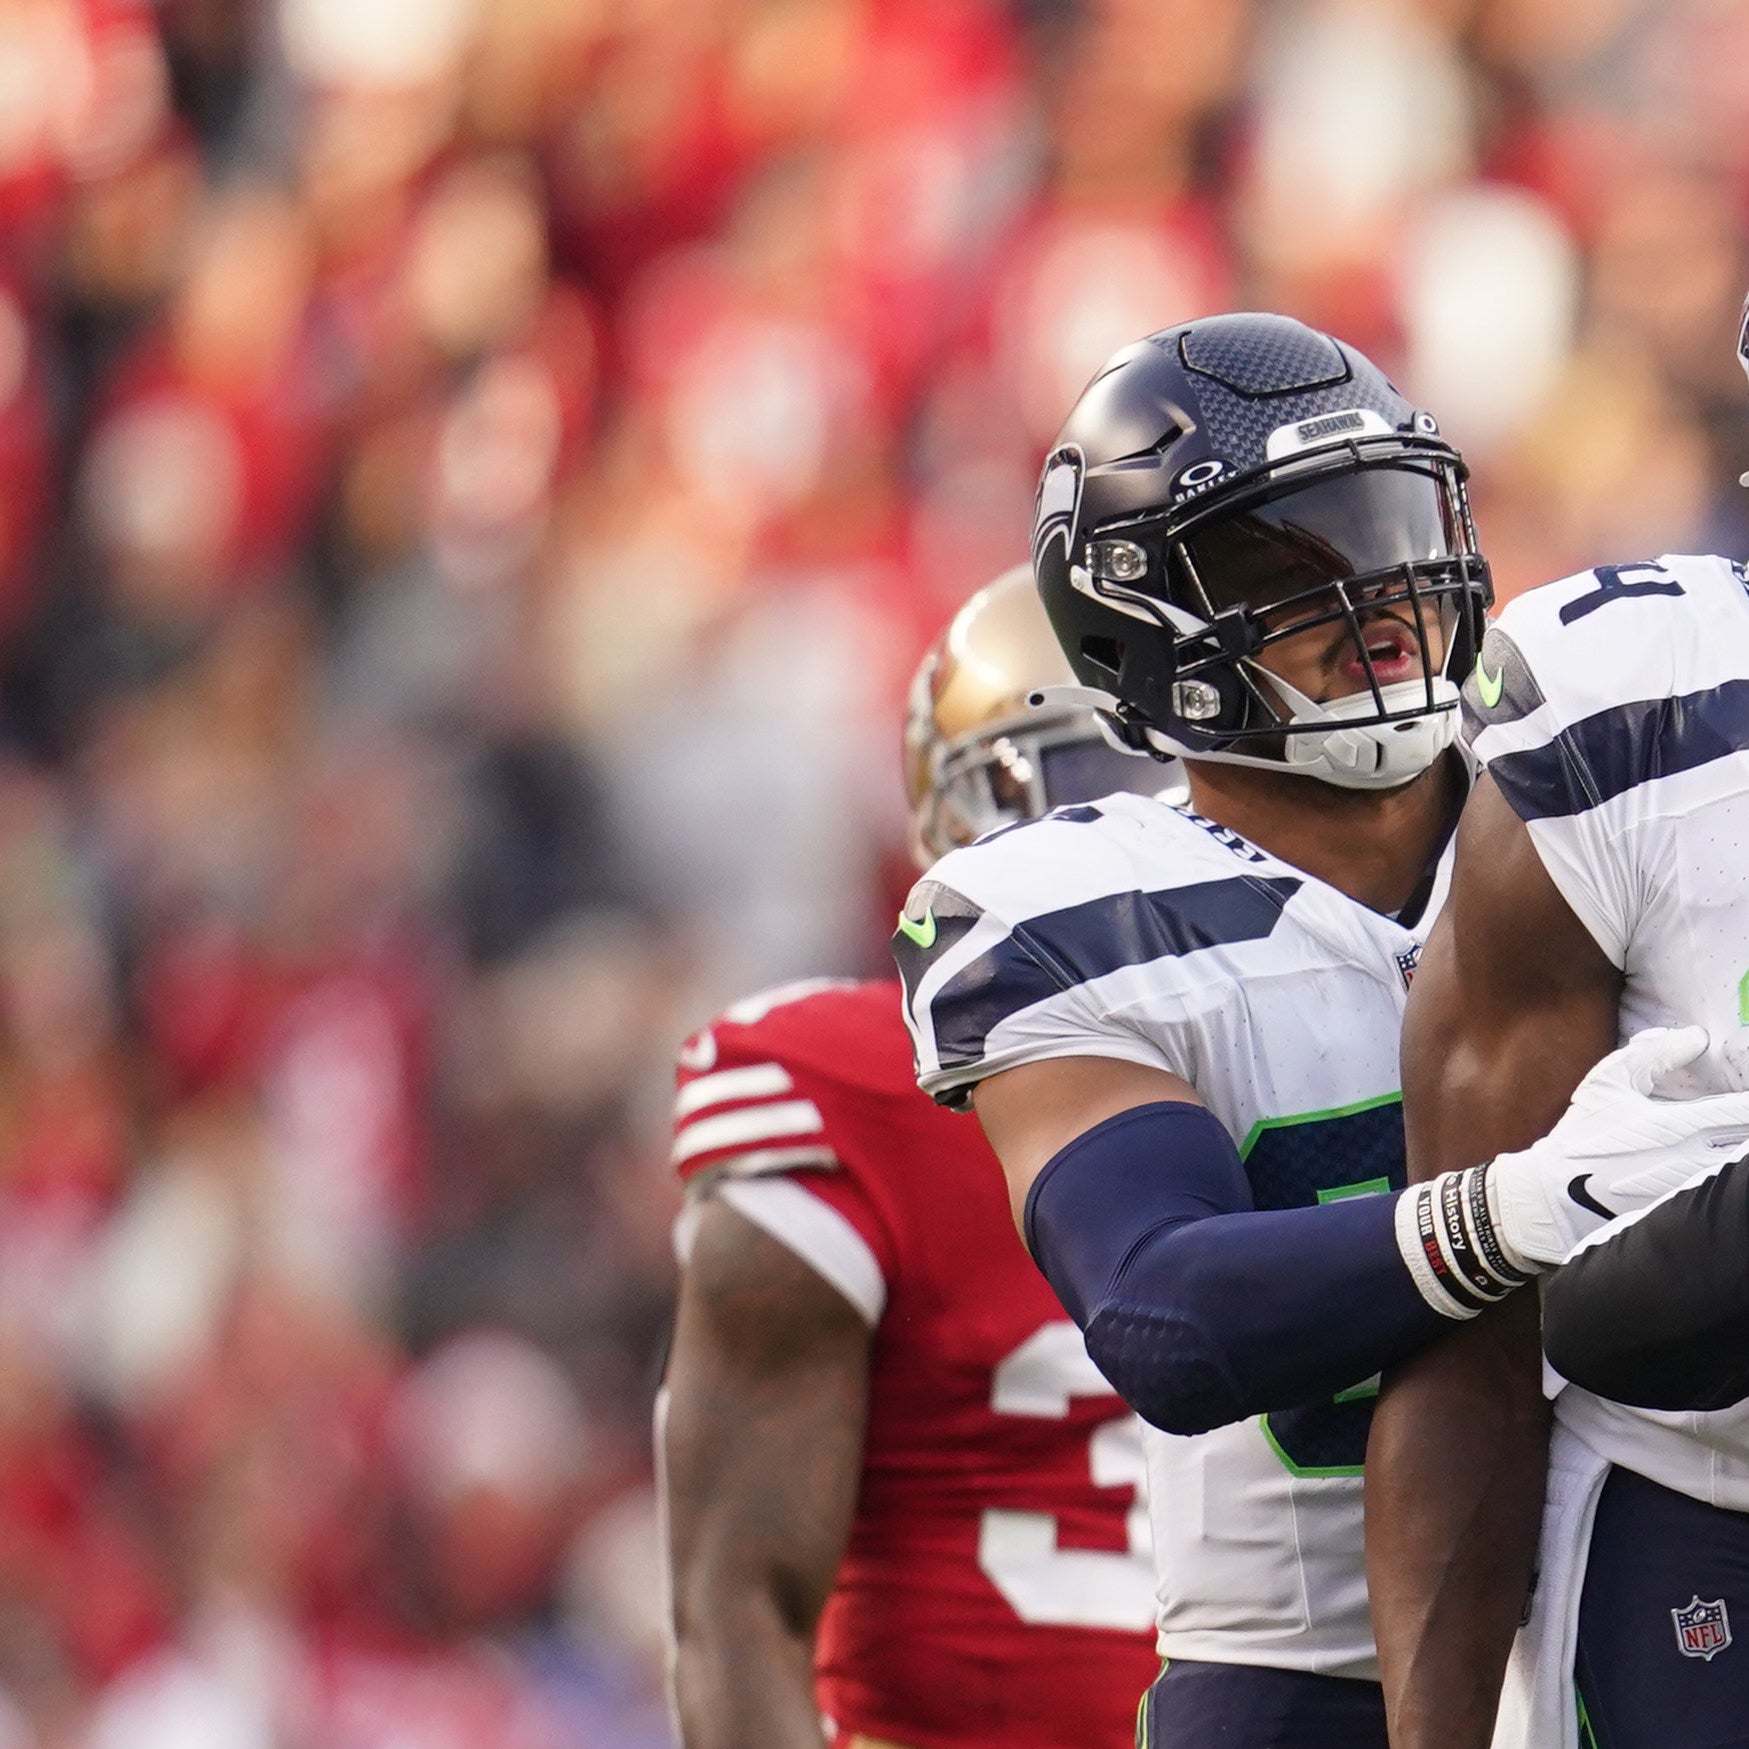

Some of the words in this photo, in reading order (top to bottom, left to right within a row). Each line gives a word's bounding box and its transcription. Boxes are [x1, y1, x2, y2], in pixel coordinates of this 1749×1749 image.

[1298, 412, 1365, 441] SEAHAWKS
[1418, 1197, 1433, 1236] YOUR
[1445, 1190, 1466, 1250] History
[1684, 1624, 1723, 1649] NFL
